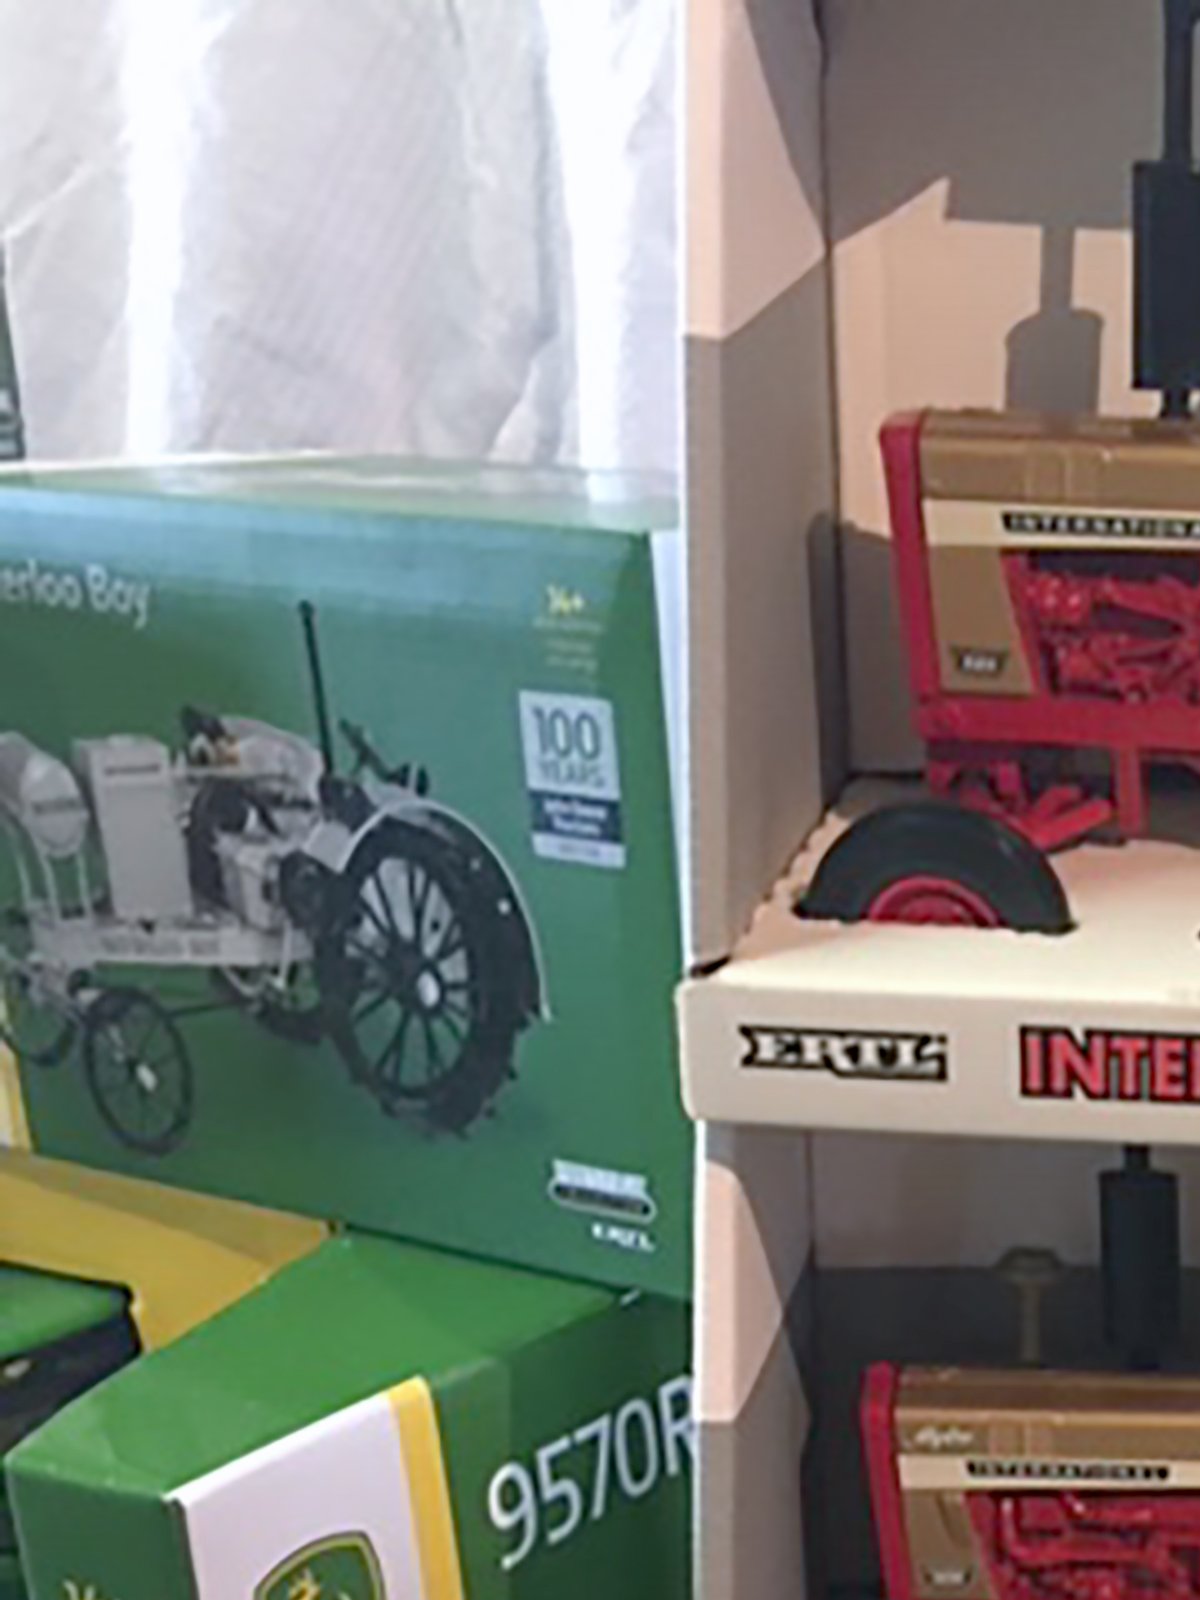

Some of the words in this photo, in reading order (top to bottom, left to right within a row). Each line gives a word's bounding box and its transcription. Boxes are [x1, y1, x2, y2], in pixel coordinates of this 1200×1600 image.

[532, 705, 600, 760] 100
[740, 1025, 947, 1082] ERTL
[487, 1373, 696, 1571] 9570R
